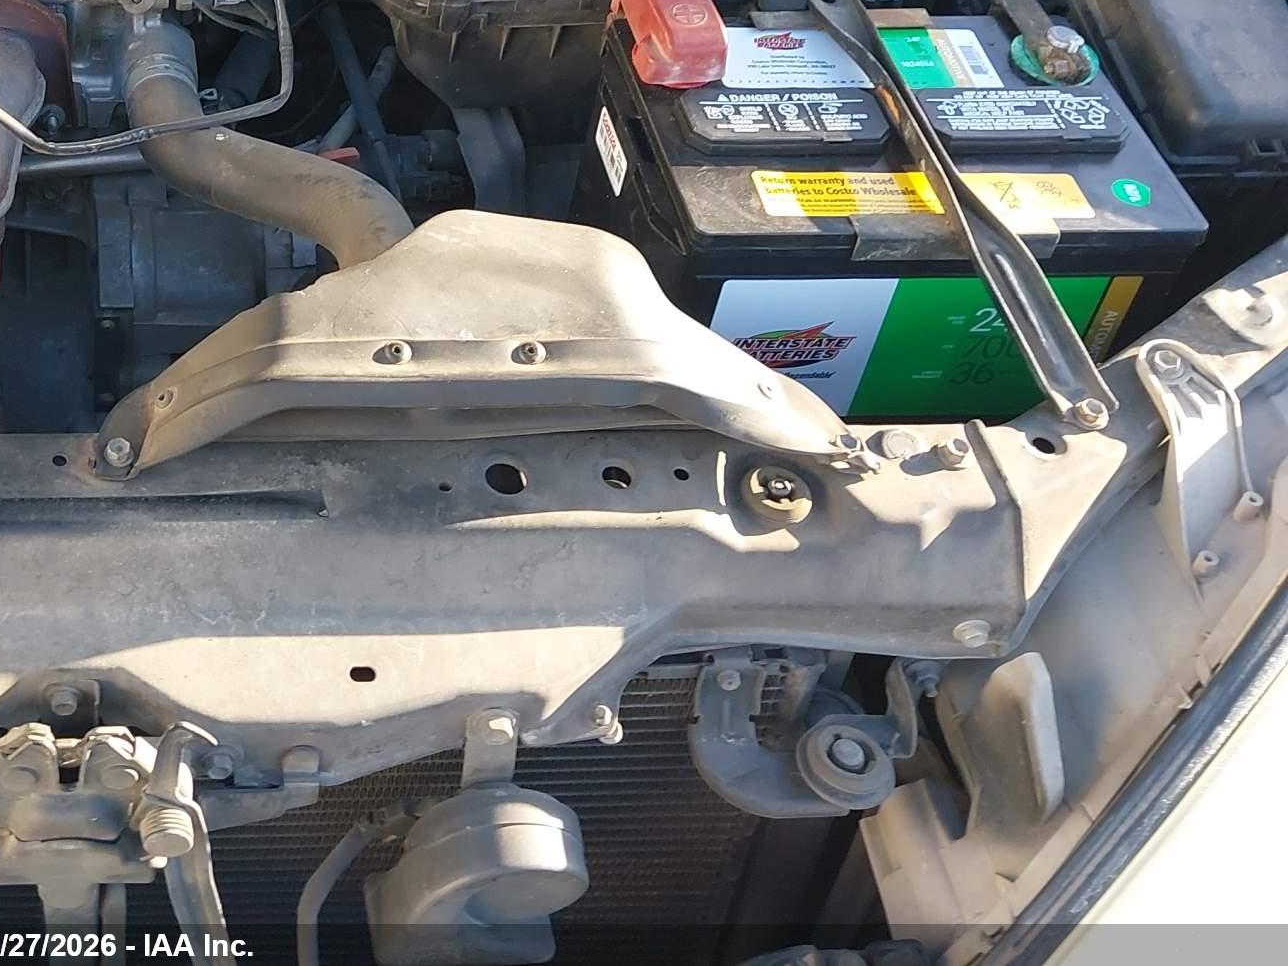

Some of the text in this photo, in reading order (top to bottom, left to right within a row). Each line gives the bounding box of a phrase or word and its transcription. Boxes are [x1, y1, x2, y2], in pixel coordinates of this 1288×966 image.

[728, 94, 781, 102] DANGER
[792, 92, 839, 101] POISON
[760, 176, 895, 186] Return warranty and used
[811, 188, 823, 196] to
[825, 187, 860, 196] Costco
[860, 187, 916, 196] Wholesale
[733, 338, 850, 350] INTERSTATE
[746, 348, 840, 362] ATTERIES
[949, 361, 996, 385] 36
